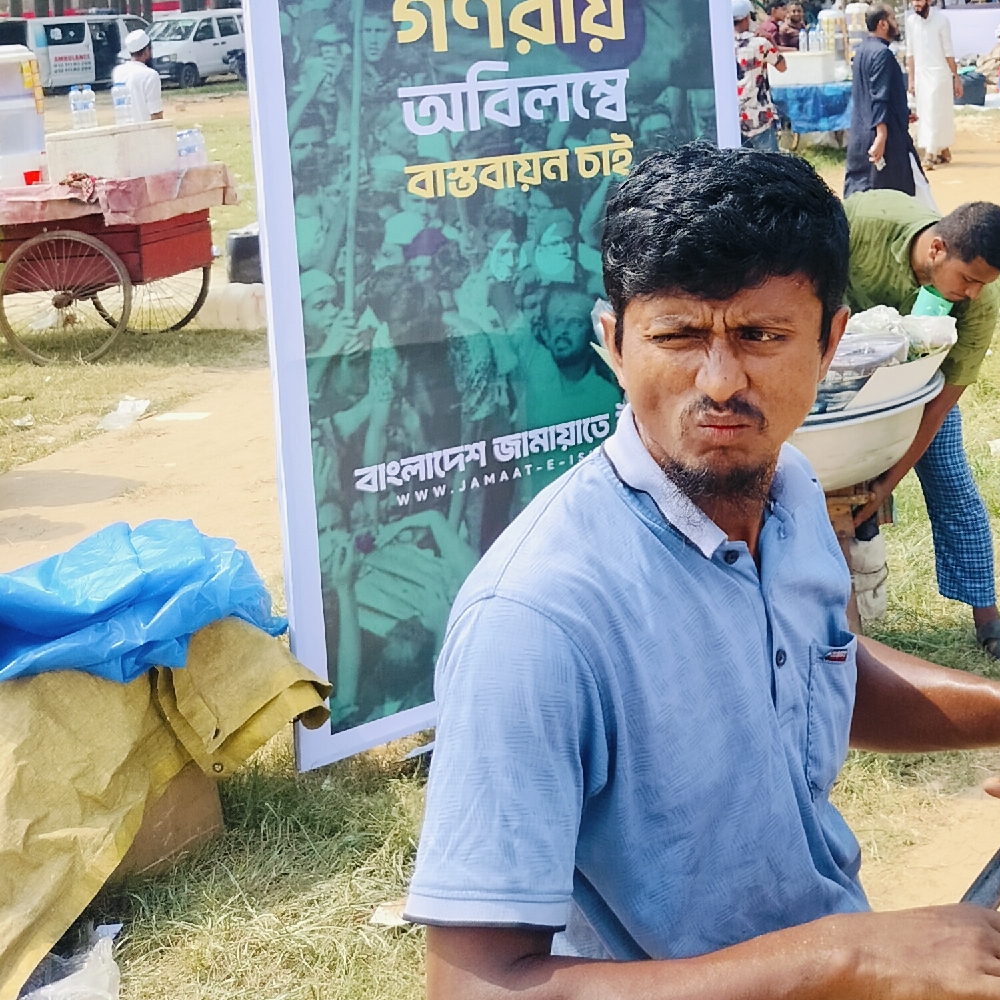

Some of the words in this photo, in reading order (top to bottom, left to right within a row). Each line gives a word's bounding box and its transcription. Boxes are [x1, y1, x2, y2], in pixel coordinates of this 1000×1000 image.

[398, 60, 629, 136] অবিলম্বে
[405, 150, 569, 200] বাস্তবায়ন
[574, 133, 634, 179] চাই
[353, 440, 486, 493] বাংলাদেশ
[492, 413, 610, 463] জামায়াতে
